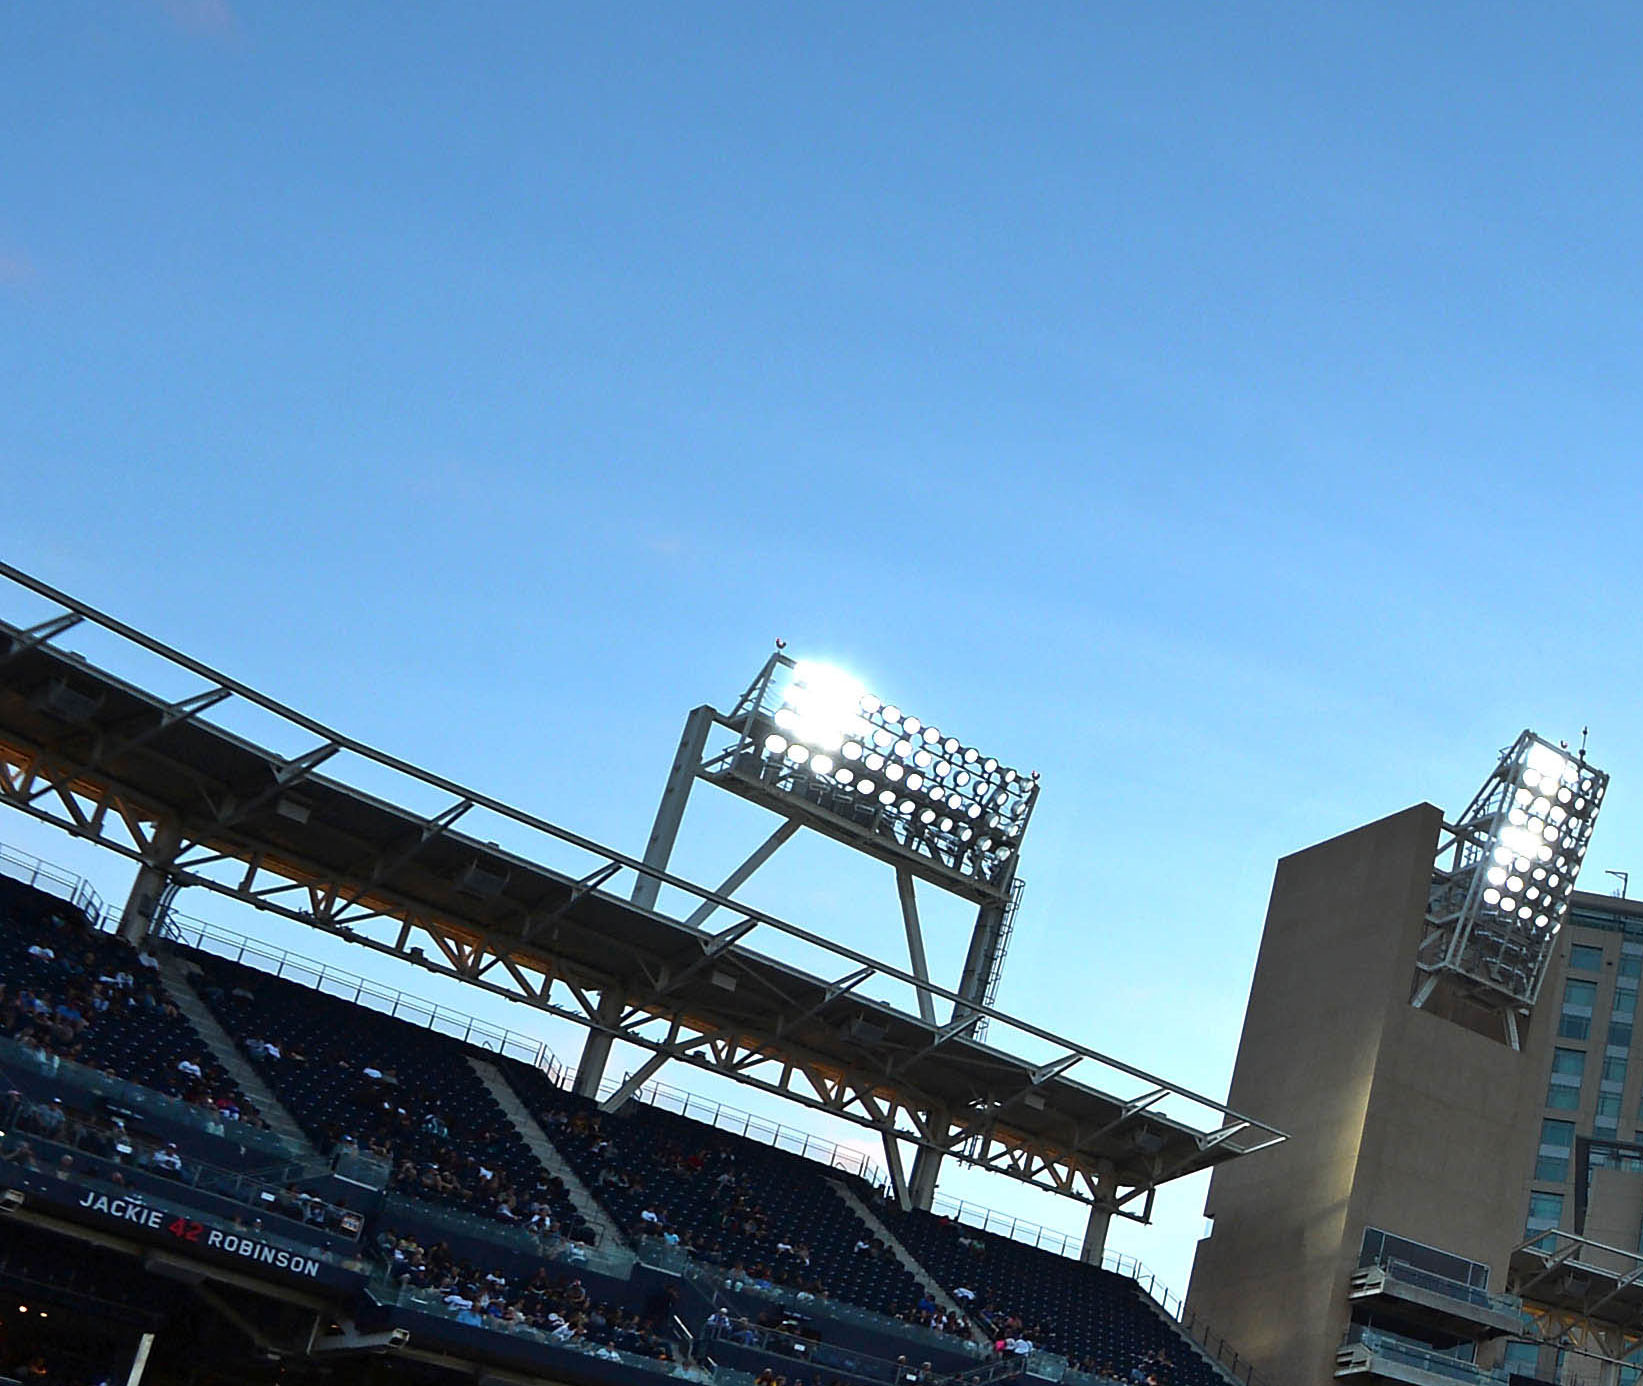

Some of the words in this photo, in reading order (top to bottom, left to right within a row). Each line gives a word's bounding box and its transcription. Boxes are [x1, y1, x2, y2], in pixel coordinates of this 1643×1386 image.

[79, 1191, 164, 1229] JACKIE
[168, 1217, 204, 1242] 42
[208, 1231, 320, 1277] ROBINSON
